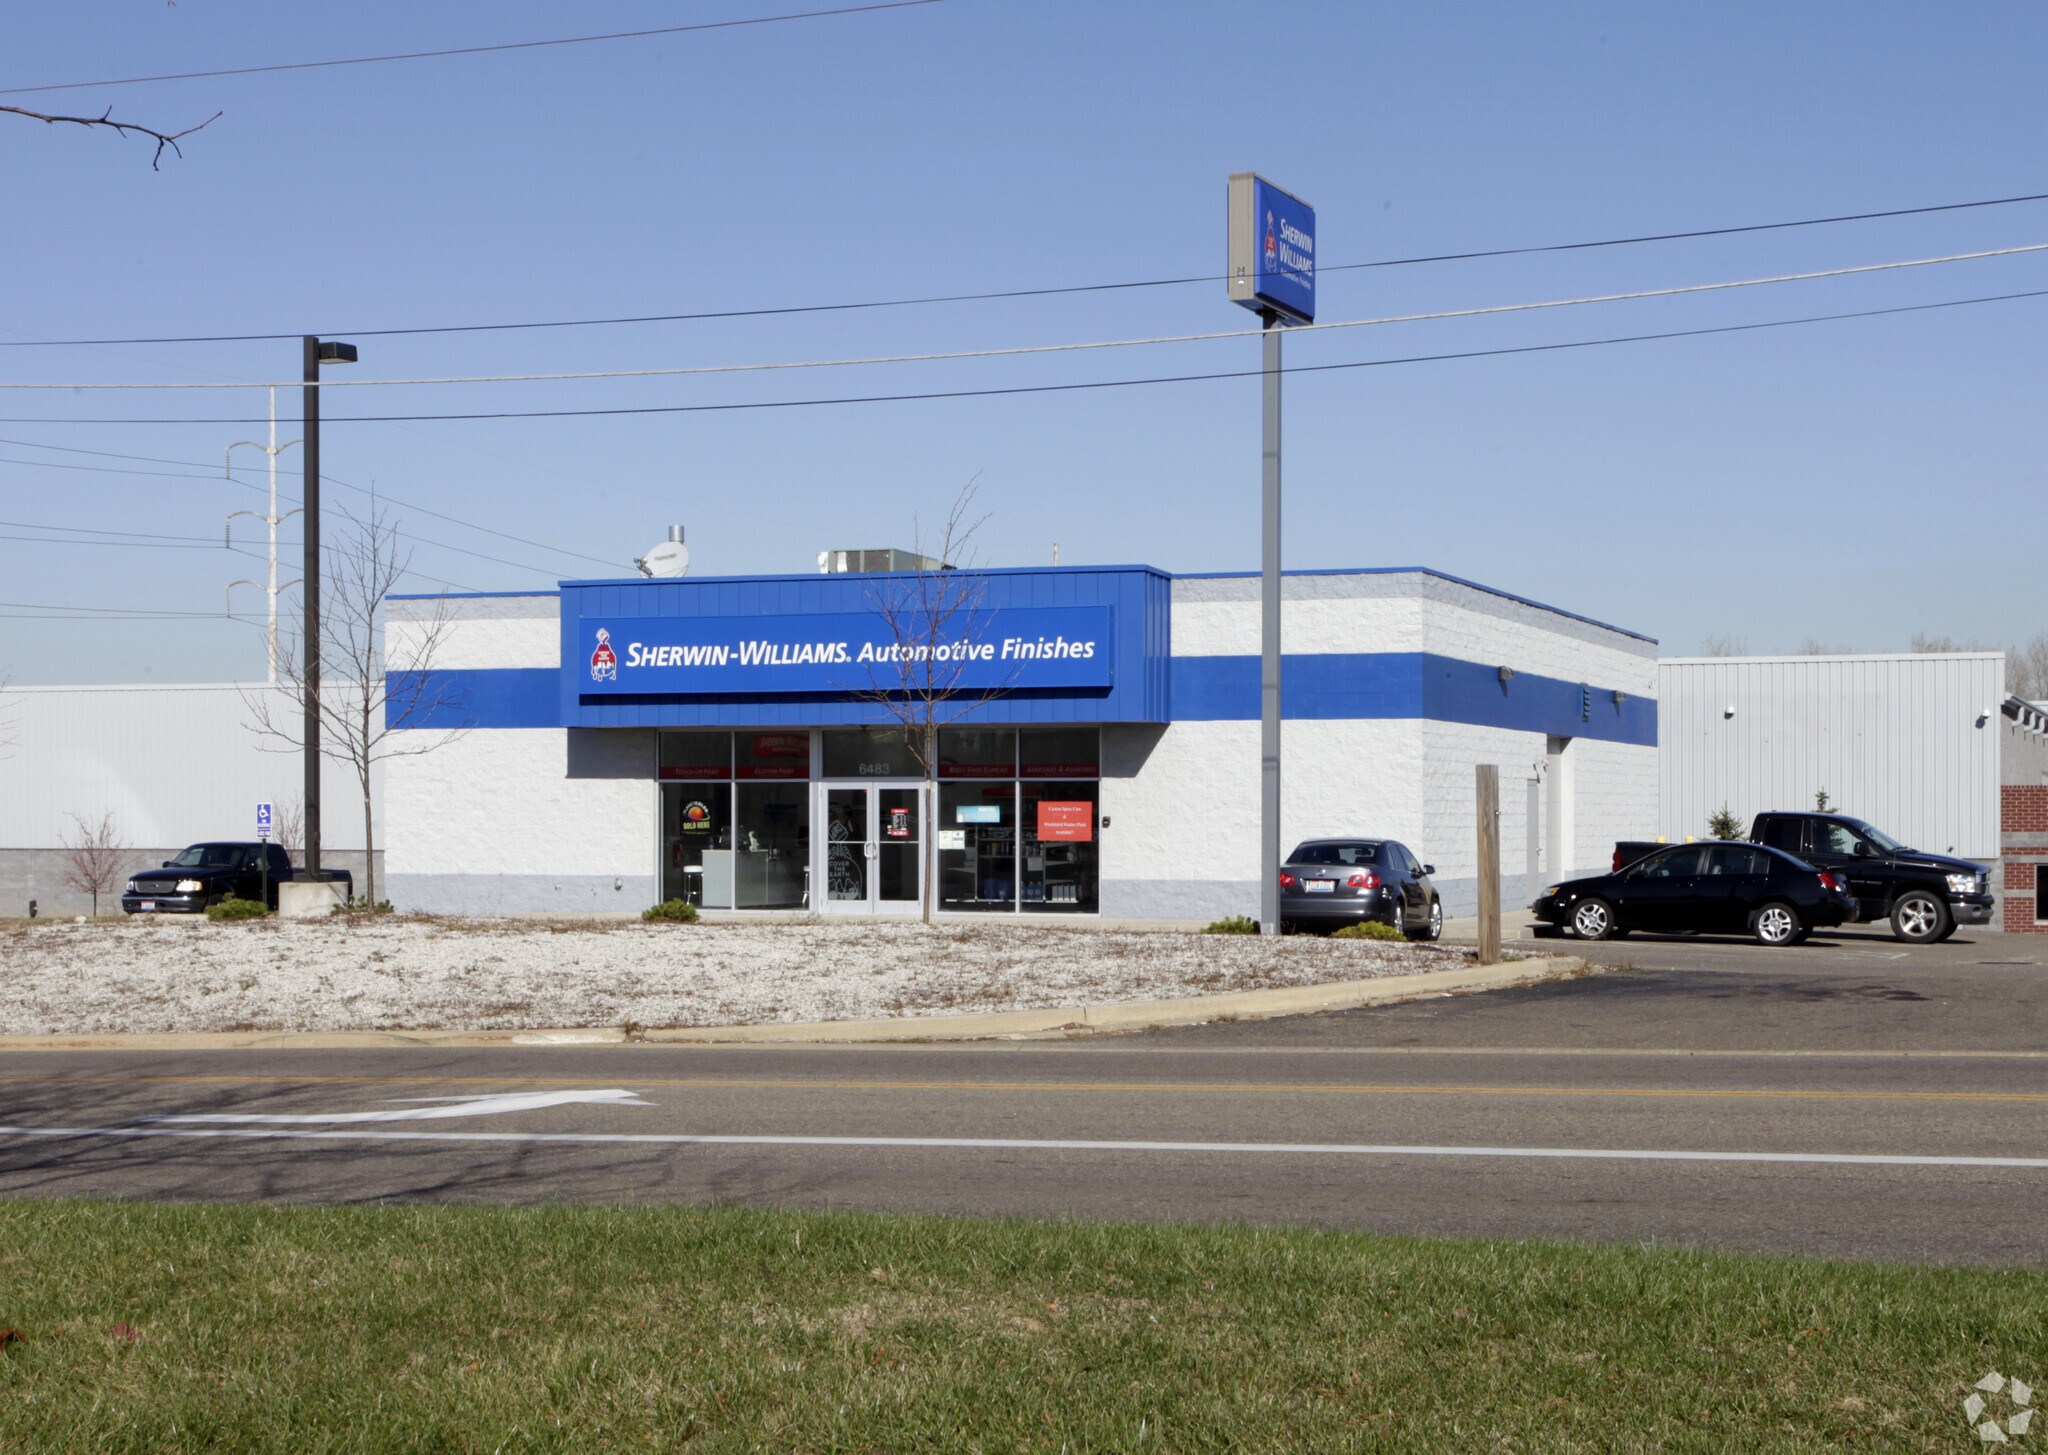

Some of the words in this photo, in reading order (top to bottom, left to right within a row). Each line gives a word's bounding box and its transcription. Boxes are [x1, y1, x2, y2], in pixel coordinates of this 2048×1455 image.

[1280, 218, 1313, 254] SHERWIN
[1280, 241, 1313, 277] WILLIAMS
[857, 638, 995, 662] Automotive
[1001, 636, 1096, 660] Finishes
[858, 763, 890, 774] 6483
[683, 822, 696, 830] SOLD
[697, 821, 710, 829] HERE
